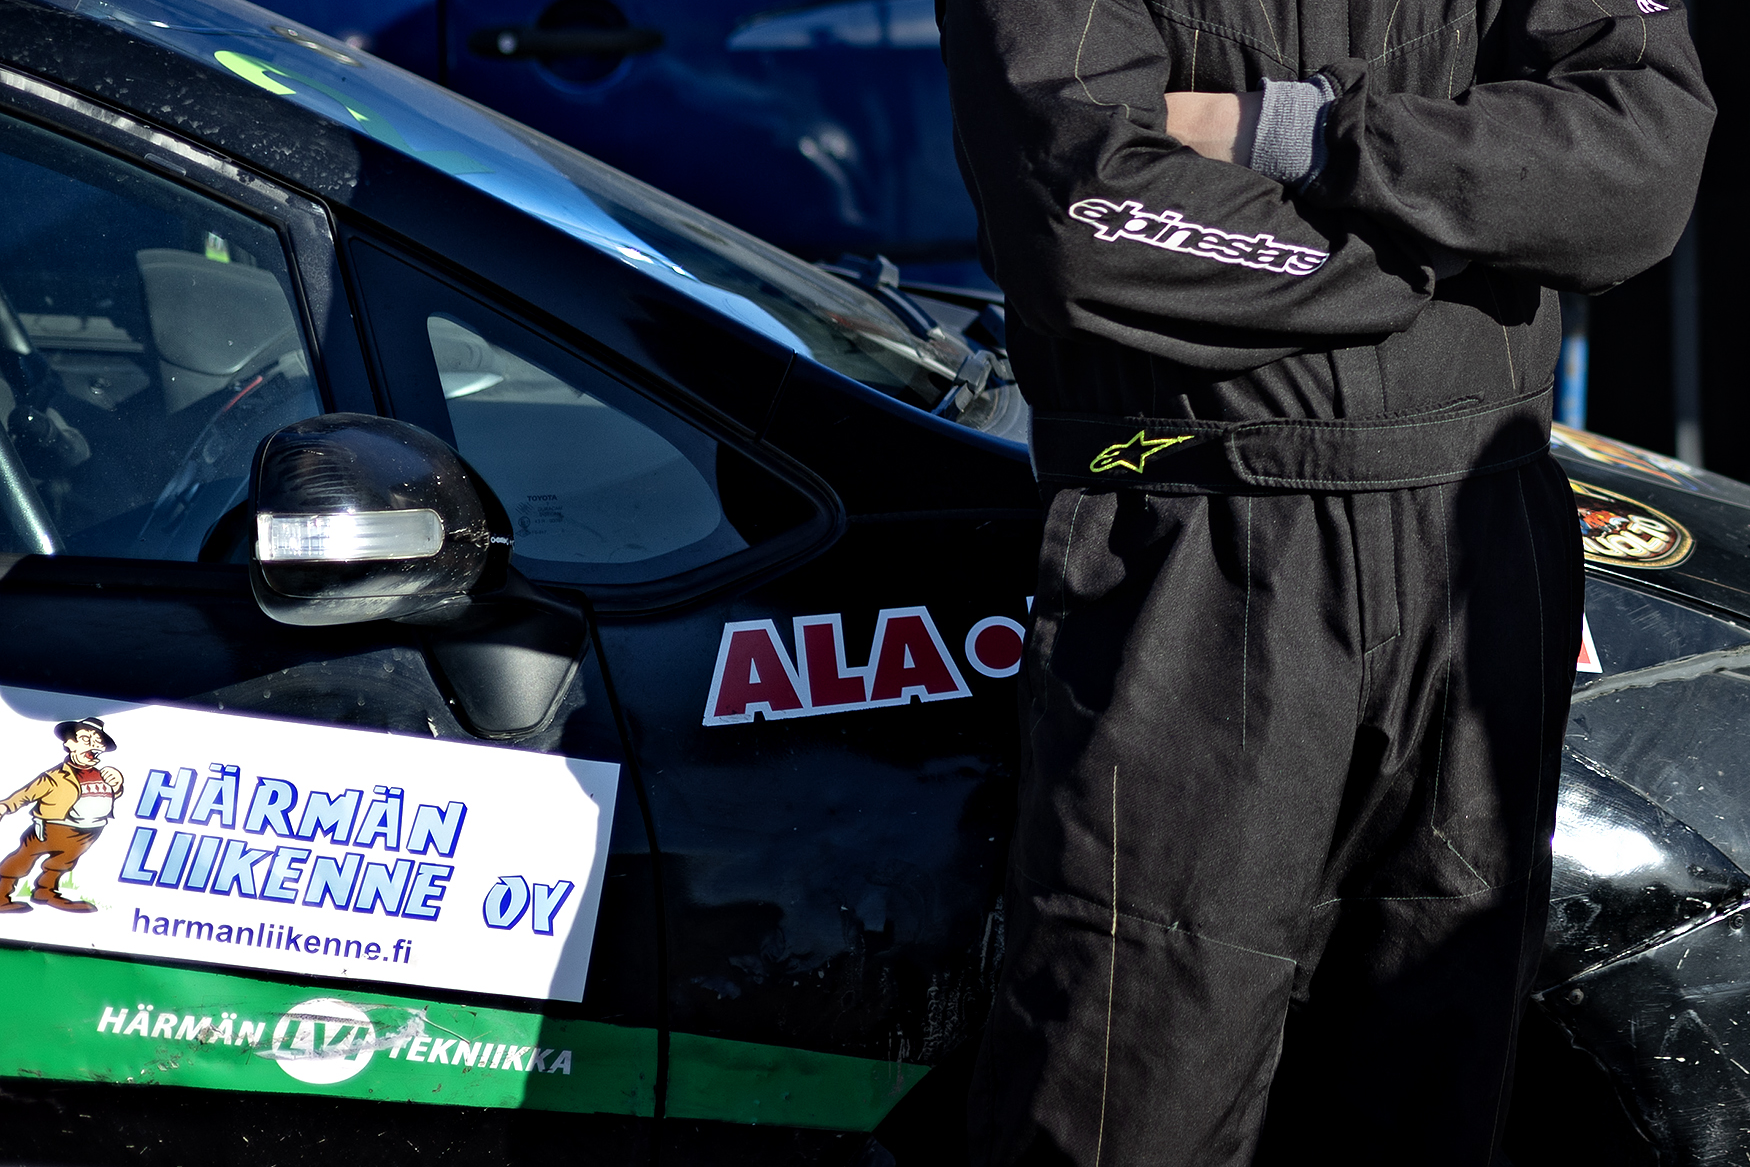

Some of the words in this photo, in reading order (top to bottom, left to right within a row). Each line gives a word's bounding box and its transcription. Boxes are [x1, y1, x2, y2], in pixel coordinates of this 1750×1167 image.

[1068, 198, 1330, 276] alpinestars
[702, 605, 973, 726] ALA
[135, 763, 468, 858] HÄRMÄN
[118, 827, 455, 921] LIIKENNE
[482, 875, 575, 936] OY
[131, 907, 412, 965] harmanliikenne.fi
[97, 1003, 266, 1048] HÄRMÄN
[387, 1030, 573, 1076] TEKNIIKKA
